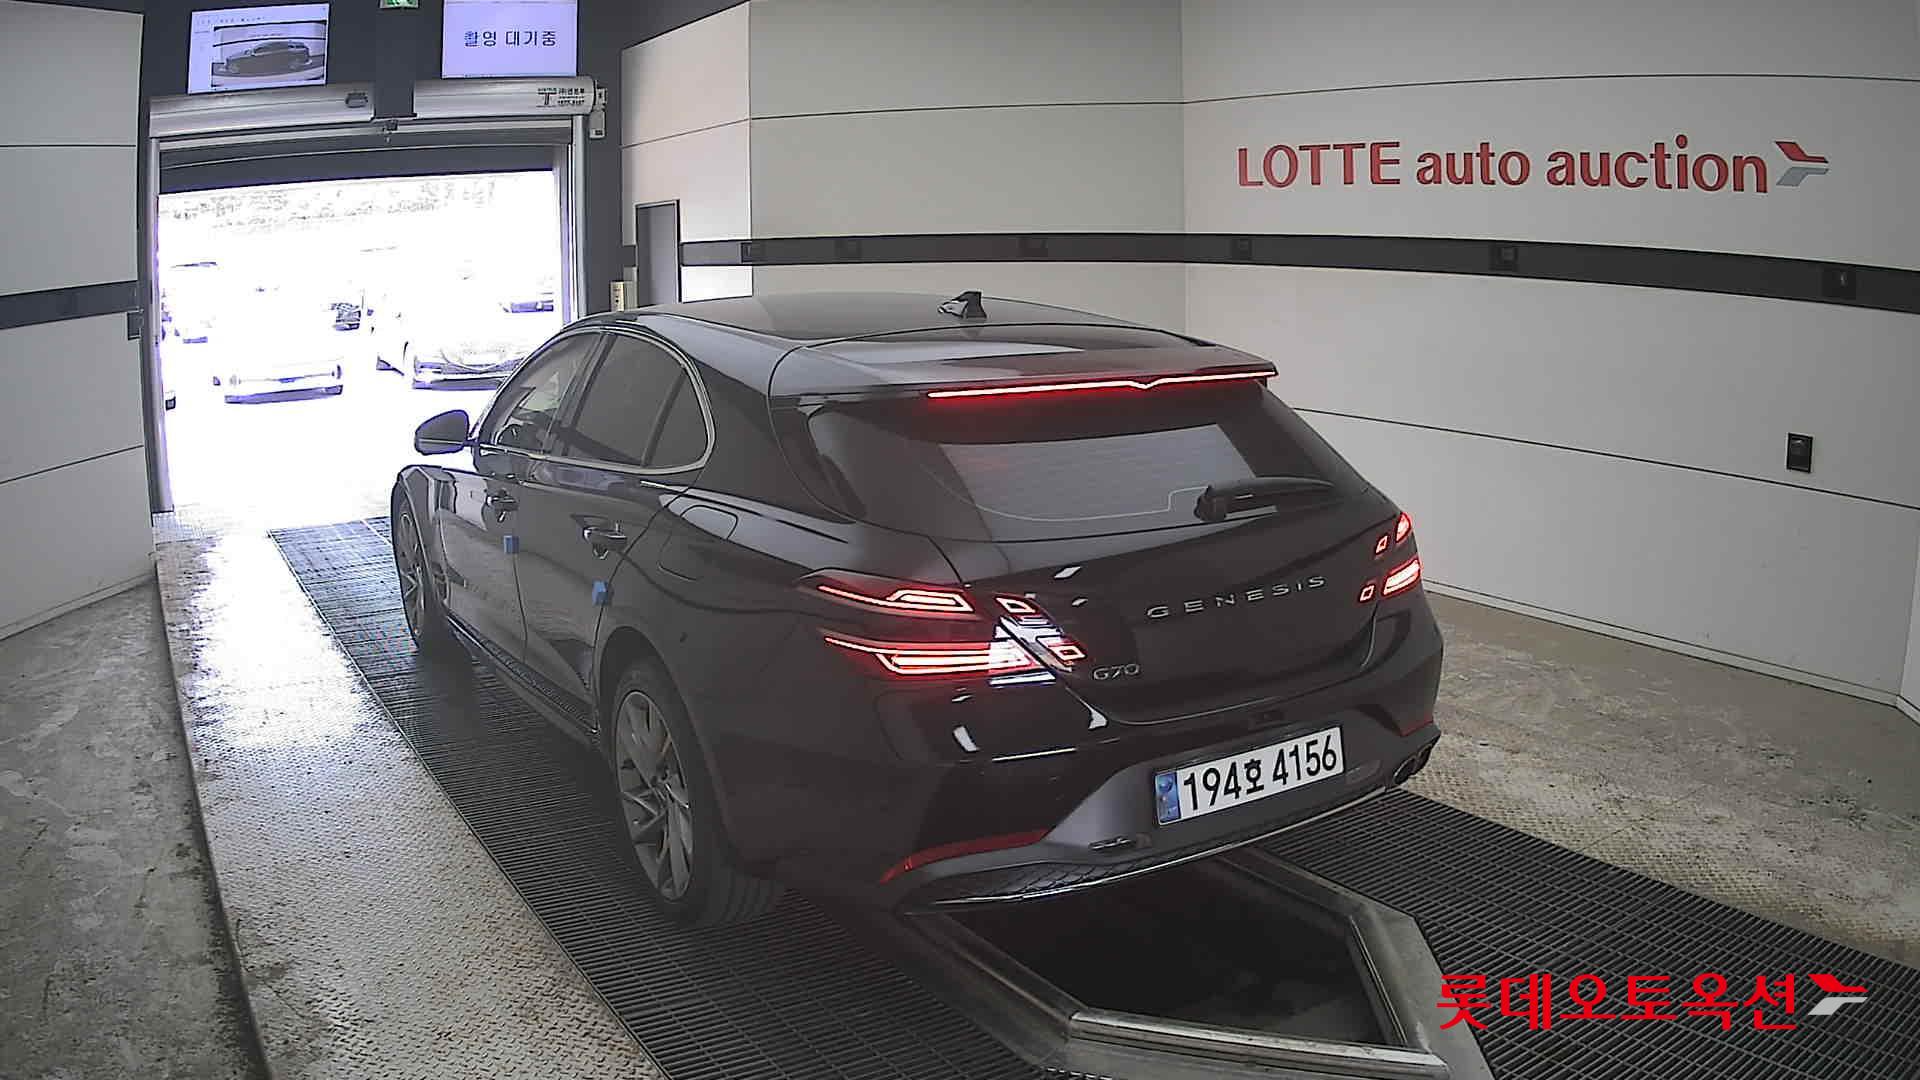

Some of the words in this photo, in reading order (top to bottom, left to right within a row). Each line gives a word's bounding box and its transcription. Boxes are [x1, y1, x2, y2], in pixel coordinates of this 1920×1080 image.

[505, 30, 557, 47] 대기중
[1237, 141, 1401, 188] LOTTE
[1416, 142, 1531, 186] auto
[1546, 134, 1768, 194] auction
[1147, 576, 1326, 618] GENESIS
[1093, 663, 1140, 680] G70
[1183, 758, 1265, 811] 194호
[1272, 735, 1337, 786] 4156
